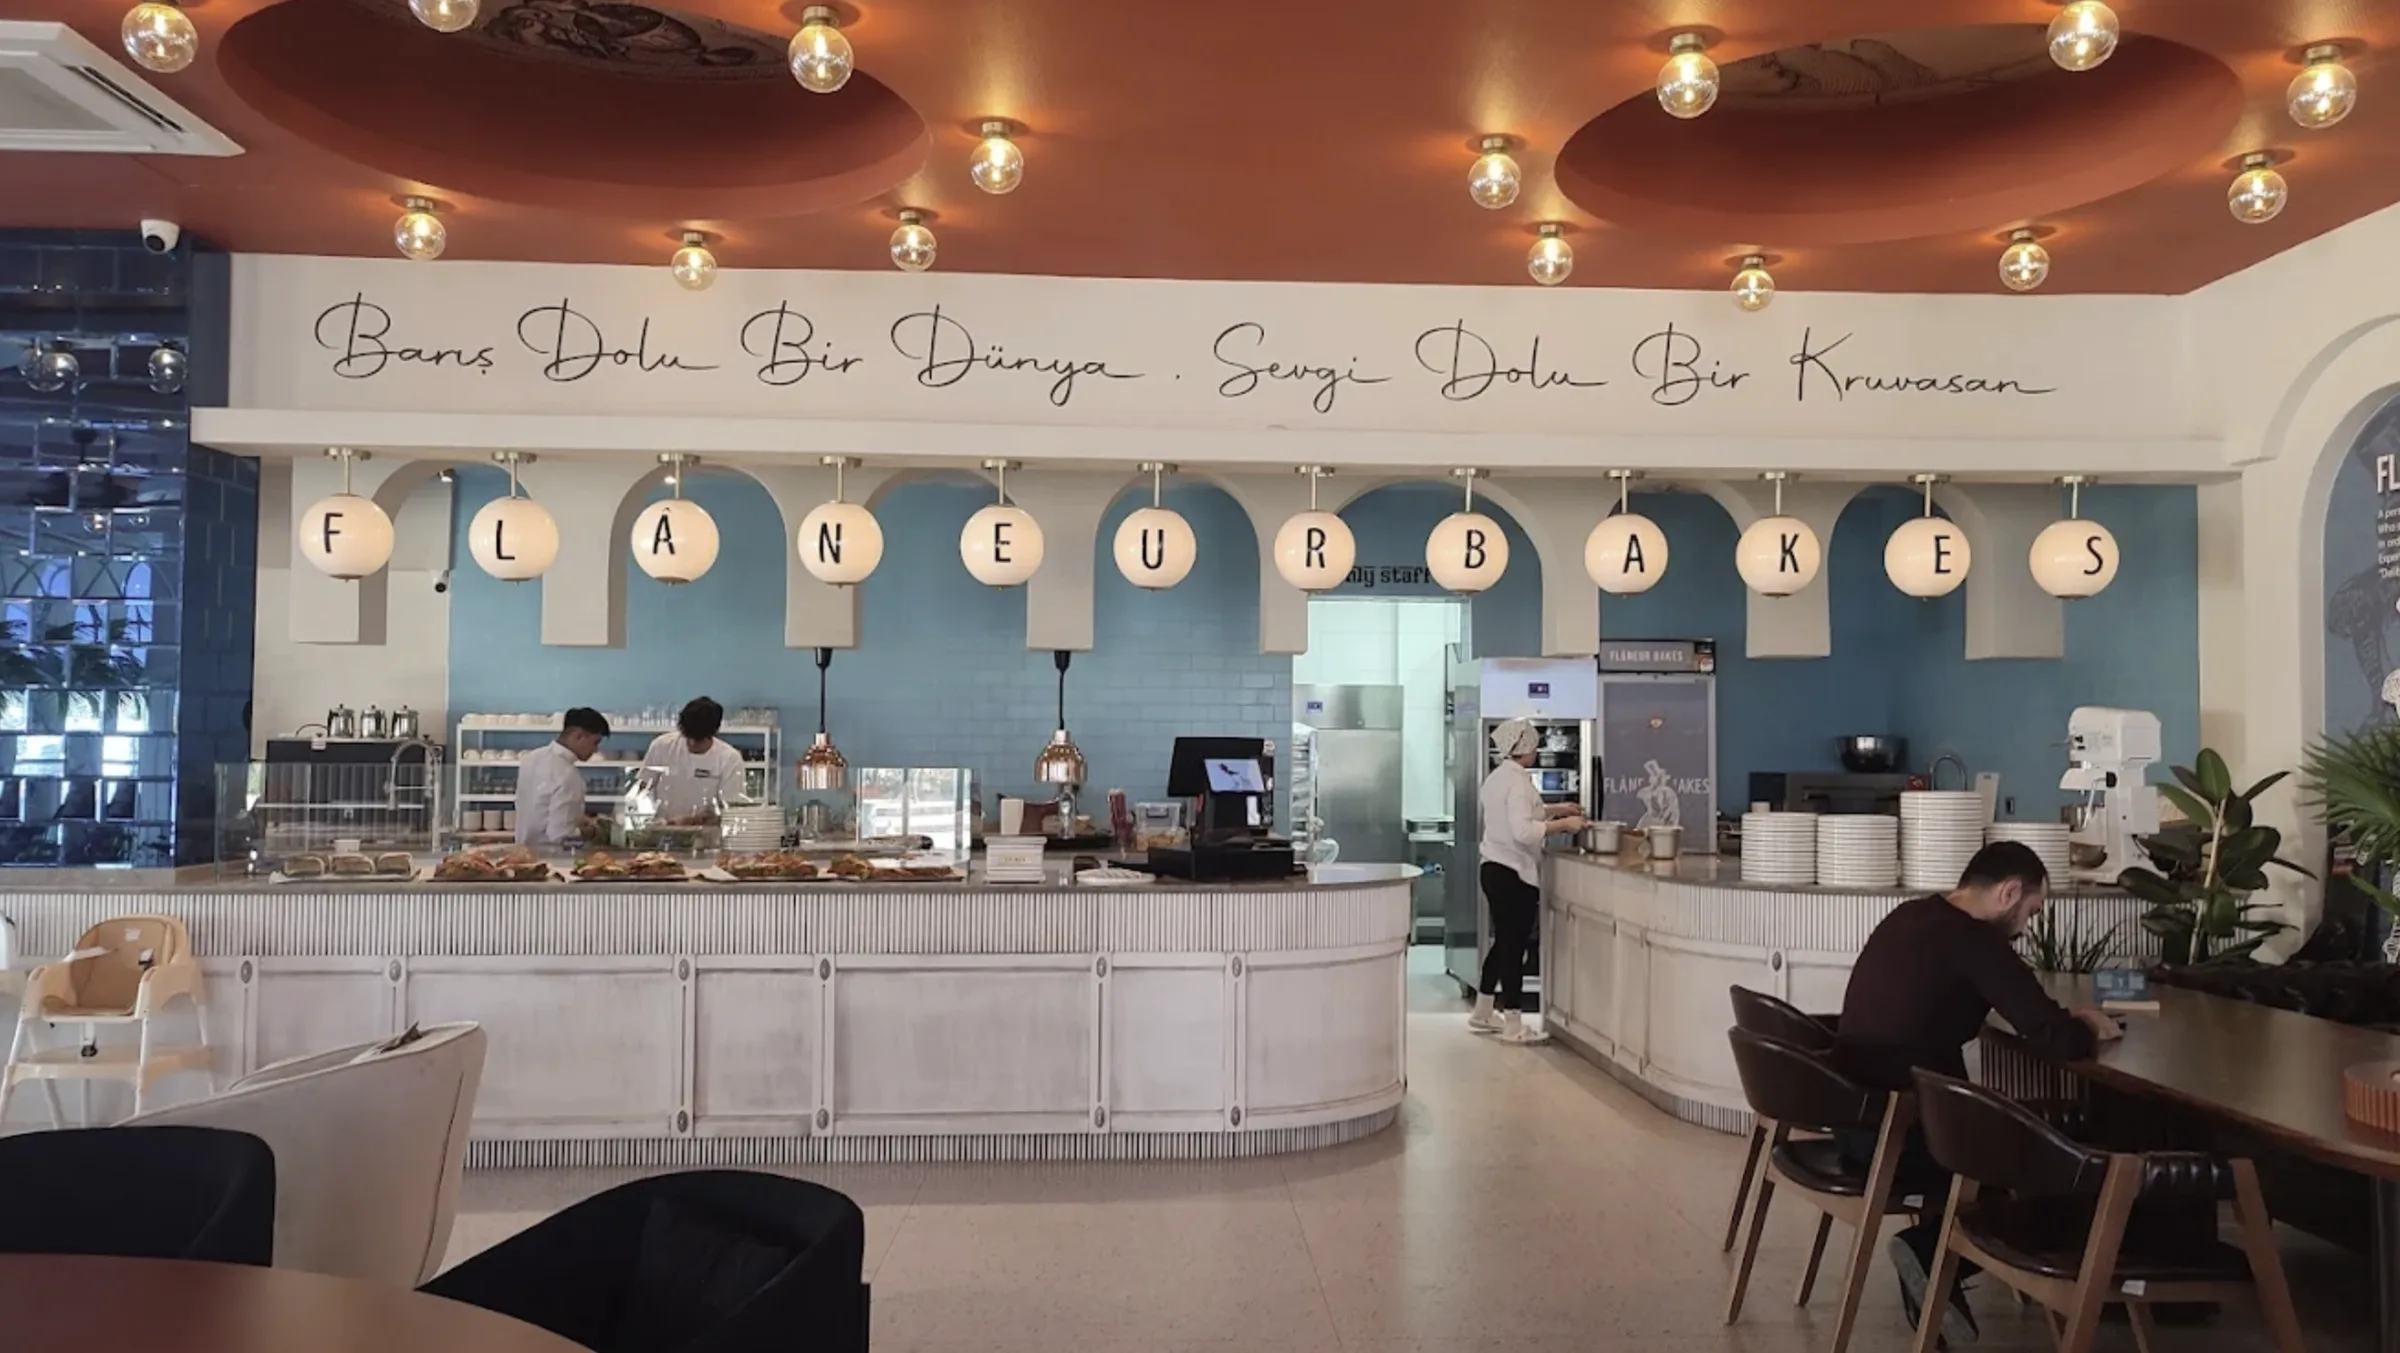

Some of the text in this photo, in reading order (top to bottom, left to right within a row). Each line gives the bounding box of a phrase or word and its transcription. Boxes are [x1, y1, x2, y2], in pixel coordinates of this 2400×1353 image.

[314, 291, 494, 380] Barış
[516, 297, 720, 383] Dolu
[740, 299, 864, 387] Bir
[890, 302, 1145, 408] Dünya
[1213, 321, 1392, 414] Sevgi
[1414, 317, 1608, 402] Dolu
[1631, 321, 1751, 407] Bir
[1789, 326, 2058, 403] Kruvasan
[1345, 566, 1375, 588] nly
